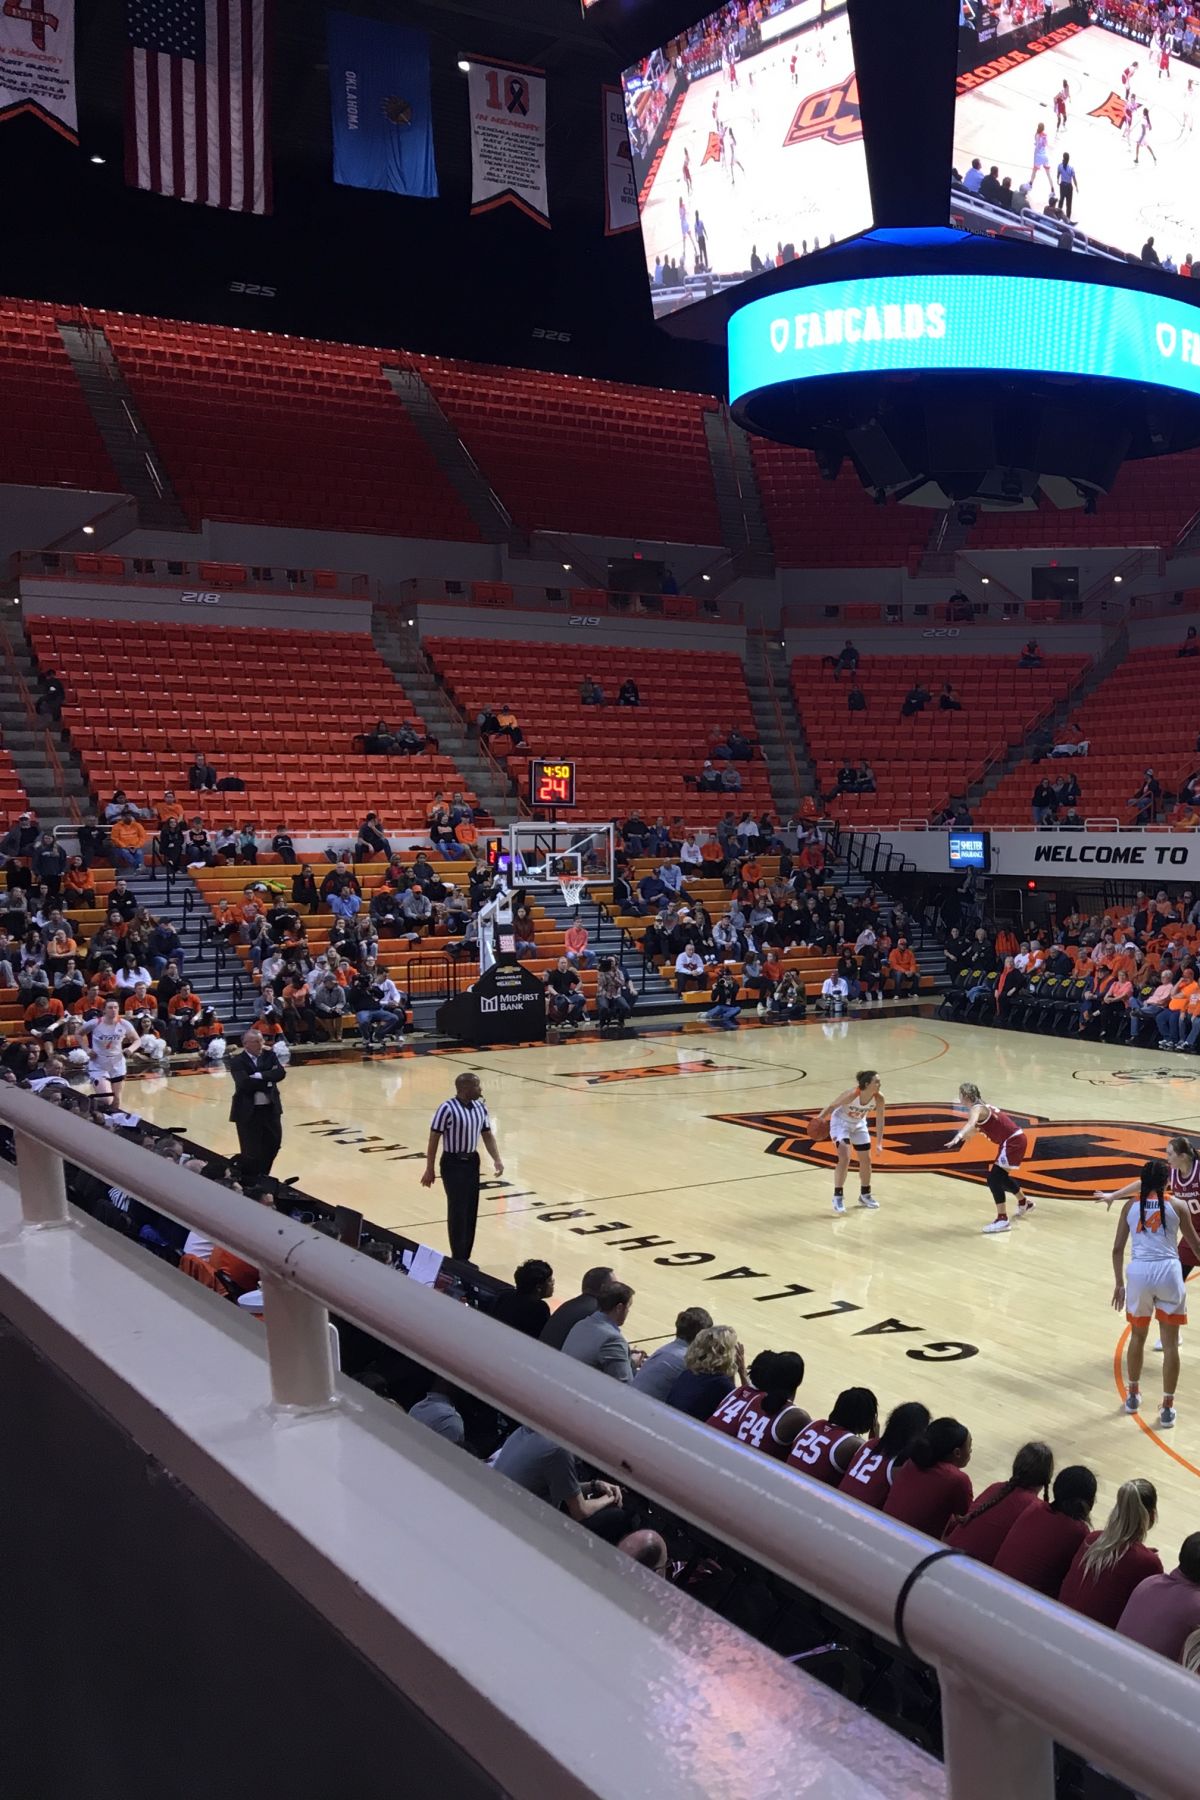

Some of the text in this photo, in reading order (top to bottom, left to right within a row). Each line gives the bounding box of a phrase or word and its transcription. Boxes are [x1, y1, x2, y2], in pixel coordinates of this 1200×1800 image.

[345, 70, 359, 130] OKLAHOMA
[229, 281, 278, 297] 325
[532, 327, 573, 343] 326
[794, 302, 947, 351] FANCARDS
[181, 591, 221, 605] 218
[568, 615, 601, 626] 219
[921, 628, 960, 639] 220
[543, 765, 570, 779] 4:50
[540, 777, 566, 800] 24
[960, 840, 983, 850] SHELTER
[960, 850, 984, 858] INSURANCE
[1034, 845, 1147, 865] WELCOME
[1155, 845, 1189, 865] TO
[713, 1394, 747, 1424] 14
[737, 1410, 770, 1448] 24
[791, 1428, 831, 1465] 25
[848, 1447, 883, 1485] 12
